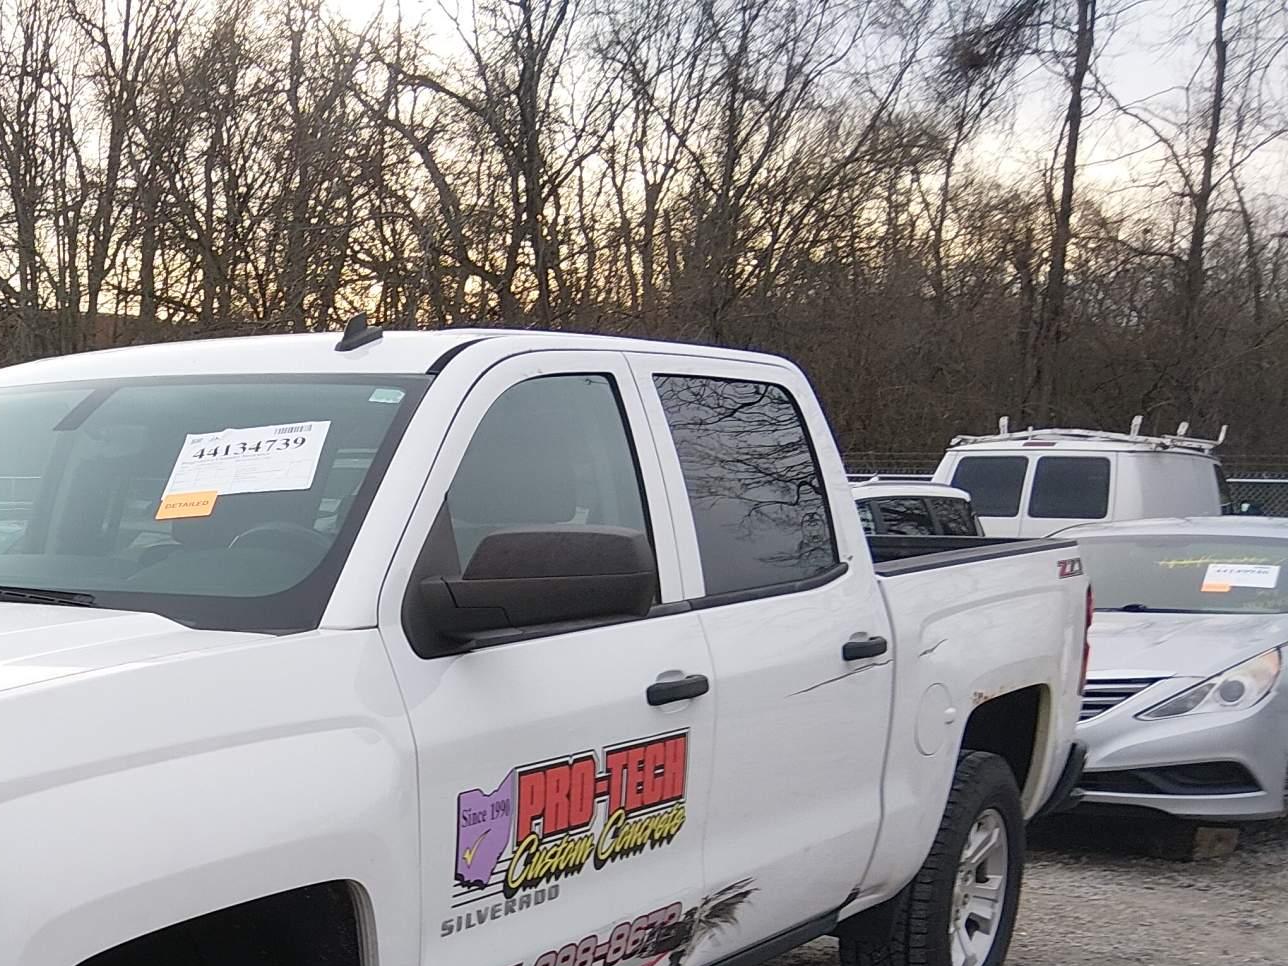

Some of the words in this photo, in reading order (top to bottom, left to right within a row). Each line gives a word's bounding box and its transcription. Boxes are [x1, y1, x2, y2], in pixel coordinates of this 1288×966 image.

[192, 436, 307, 460] 44134739
[165, 500, 210, 510] DETAILED
[1057, 557, 1084, 579] Z71
[515, 731, 690, 846] PRO-TECH
[462, 808, 488, 828] Since
[507, 831, 595, 890] Custom
[596, 803, 688, 862] Concrete
[440, 884, 560, 938] SILVERADO
